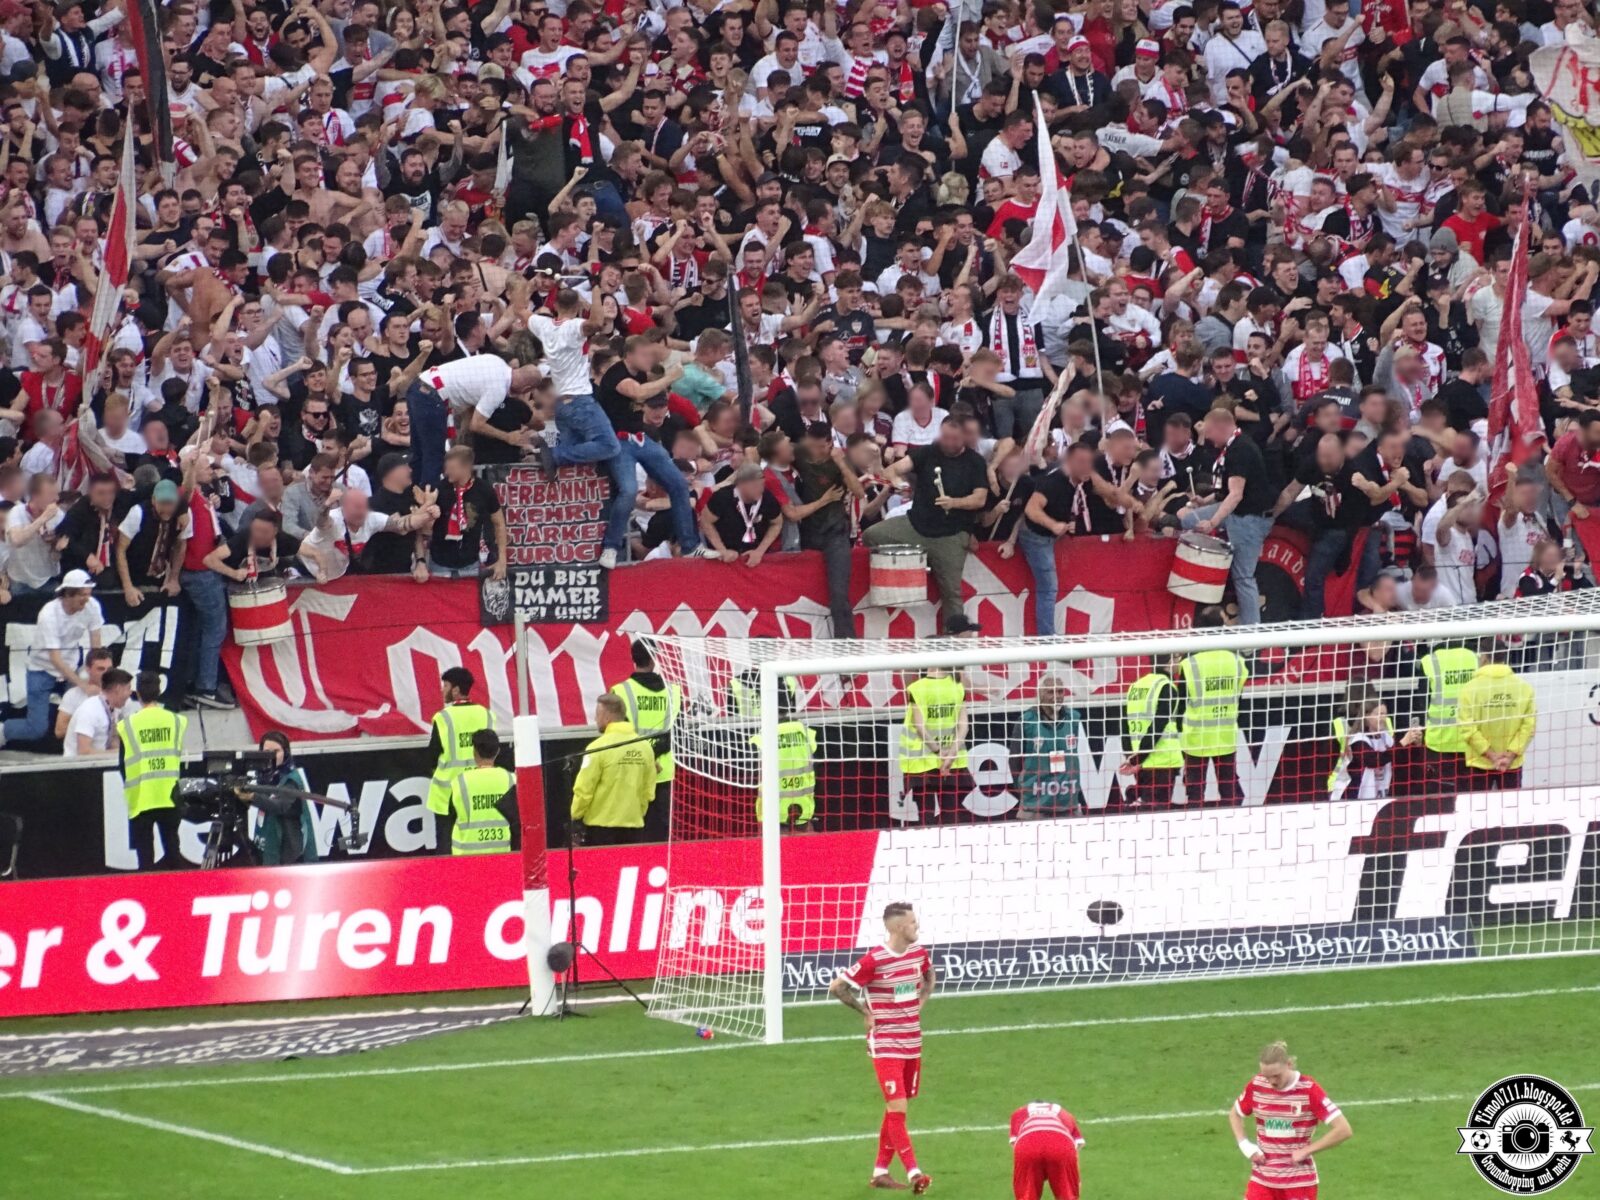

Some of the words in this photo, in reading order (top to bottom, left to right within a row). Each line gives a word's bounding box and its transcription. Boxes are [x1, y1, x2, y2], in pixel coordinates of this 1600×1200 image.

[493, 477, 610, 506] VERBANNTE
[505, 502, 603, 525] KEHRT
[515, 571, 545, 586] DU
[555, 569, 601, 586] BIST
[515, 586, 600, 606] IMMER
[555, 605, 602, 620] UNS!
[637, 693, 668, 713] SECURITY
[139, 727, 171, 744] SECURITY
[148, 758, 166, 770] 1639
[1033, 780, 1078, 796] HOST
[478, 829, 504, 842] 3233
[86, 899, 161, 985] &
[192, 889, 453, 977] Türen
[1135, 935, 1371, 967] Mercedes-Benz
[1378, 924, 1462, 953] Bank
[1028, 946, 1111, 976] Bank
